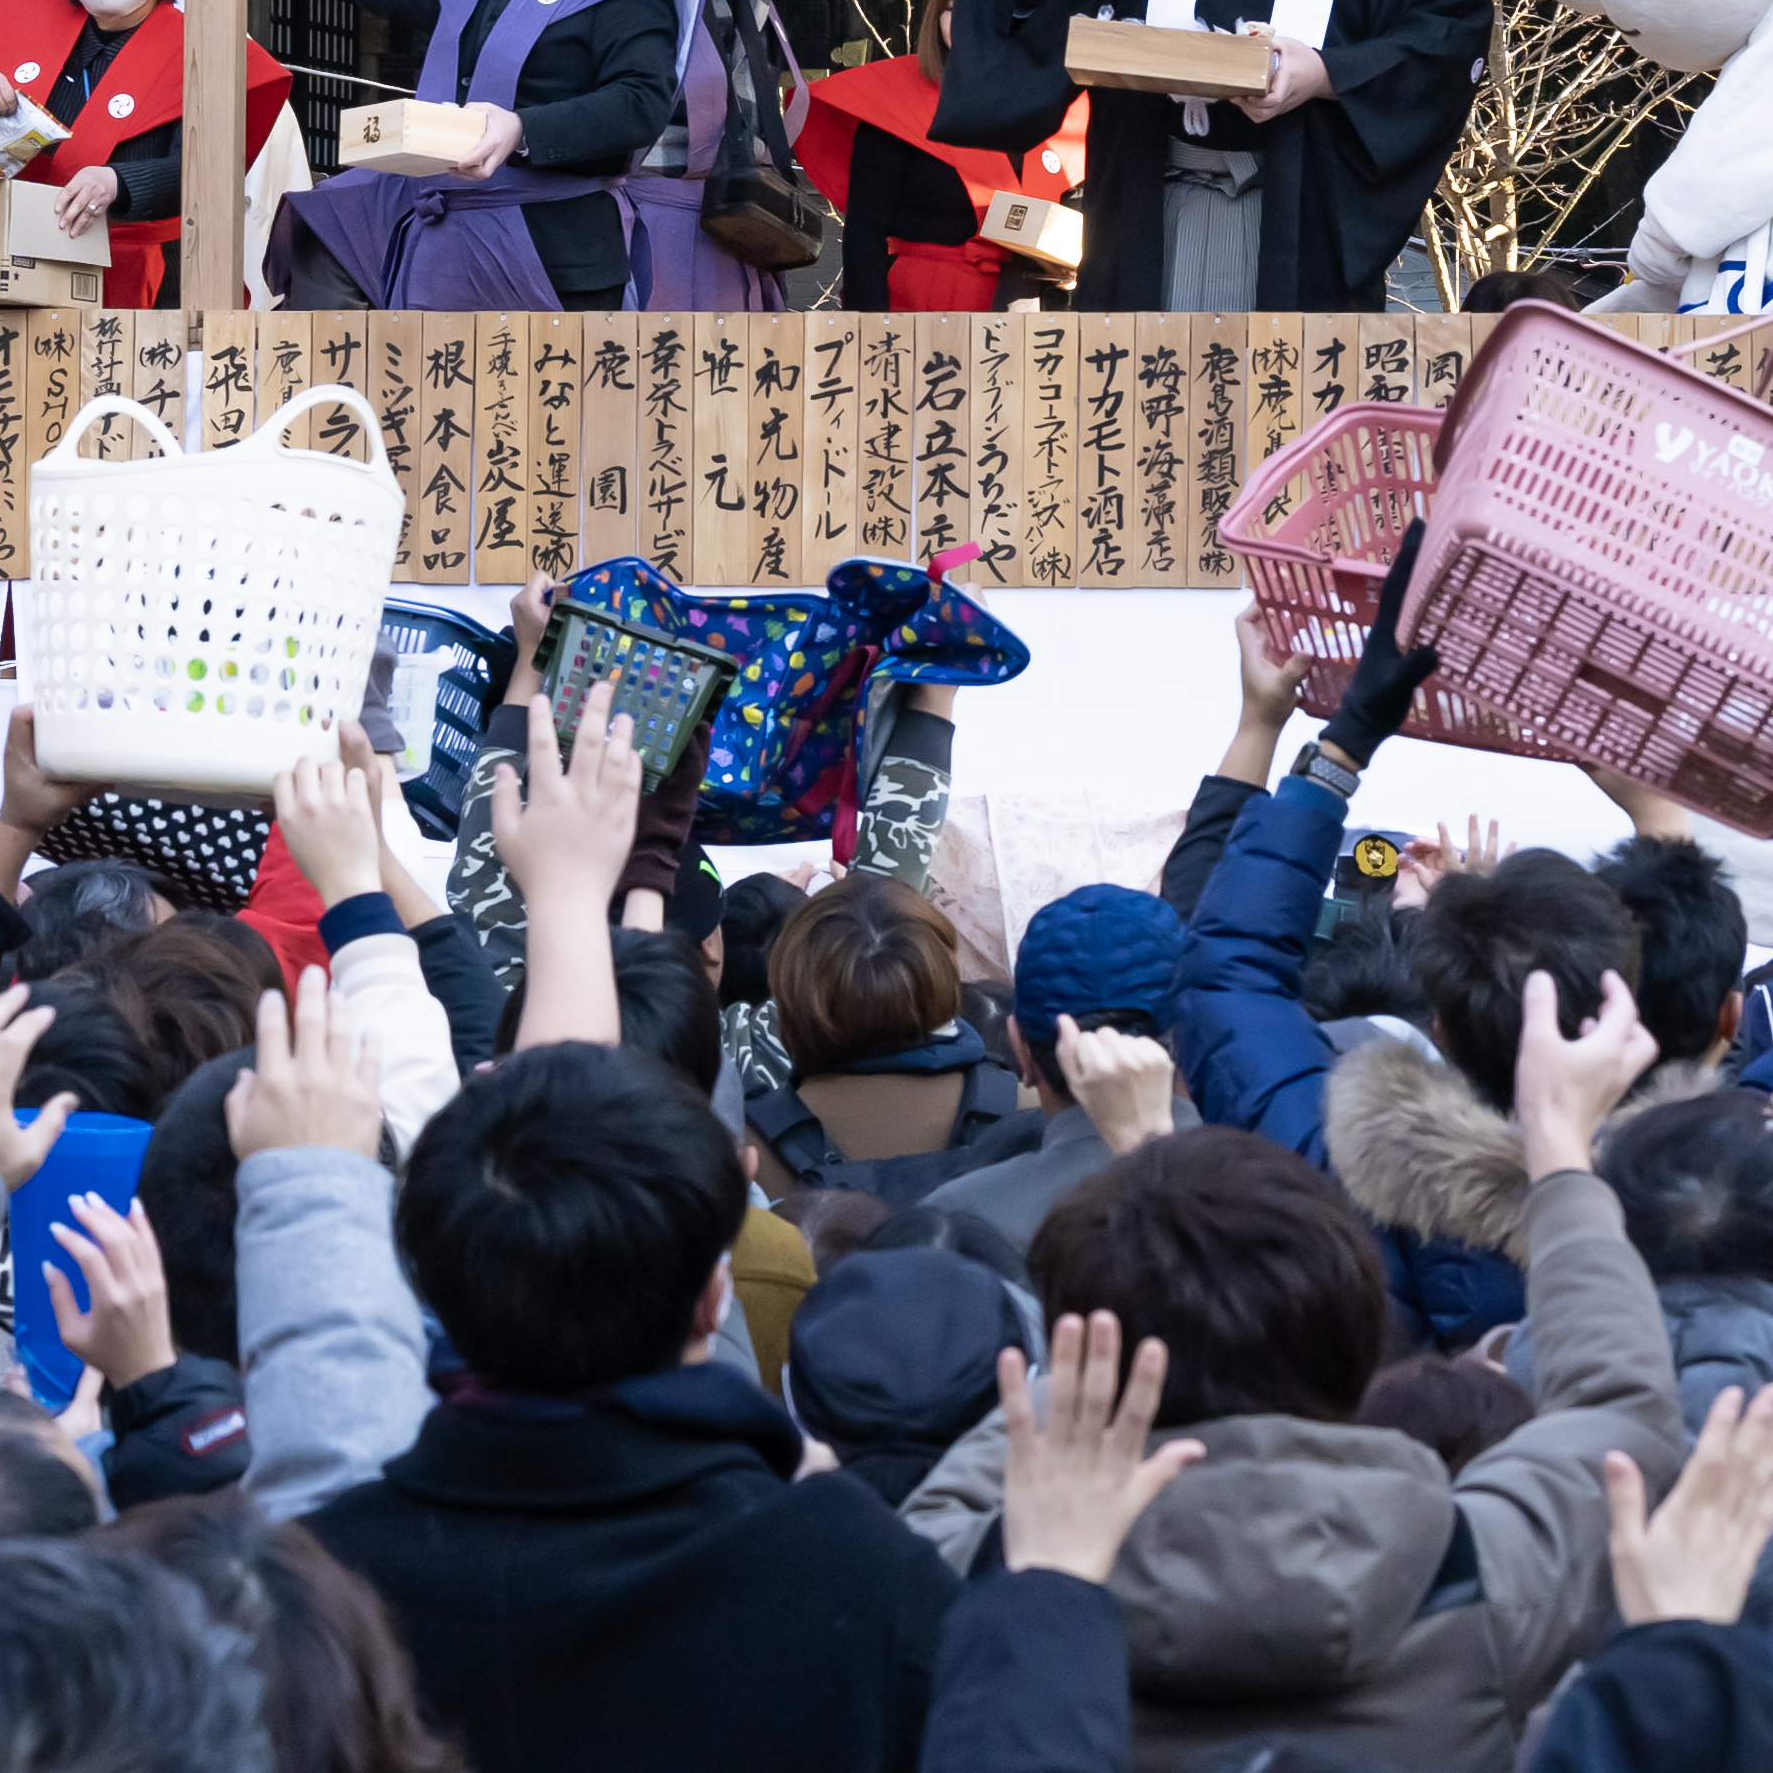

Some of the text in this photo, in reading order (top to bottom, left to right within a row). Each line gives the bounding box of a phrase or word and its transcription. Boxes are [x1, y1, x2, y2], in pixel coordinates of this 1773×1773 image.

[362, 115, 381, 145] 福
[422, 340, 473, 570] 根本食品
[750, 347, 801, 584] 和光物産
[1082, 342, 1130, 577] サカモト酒店
